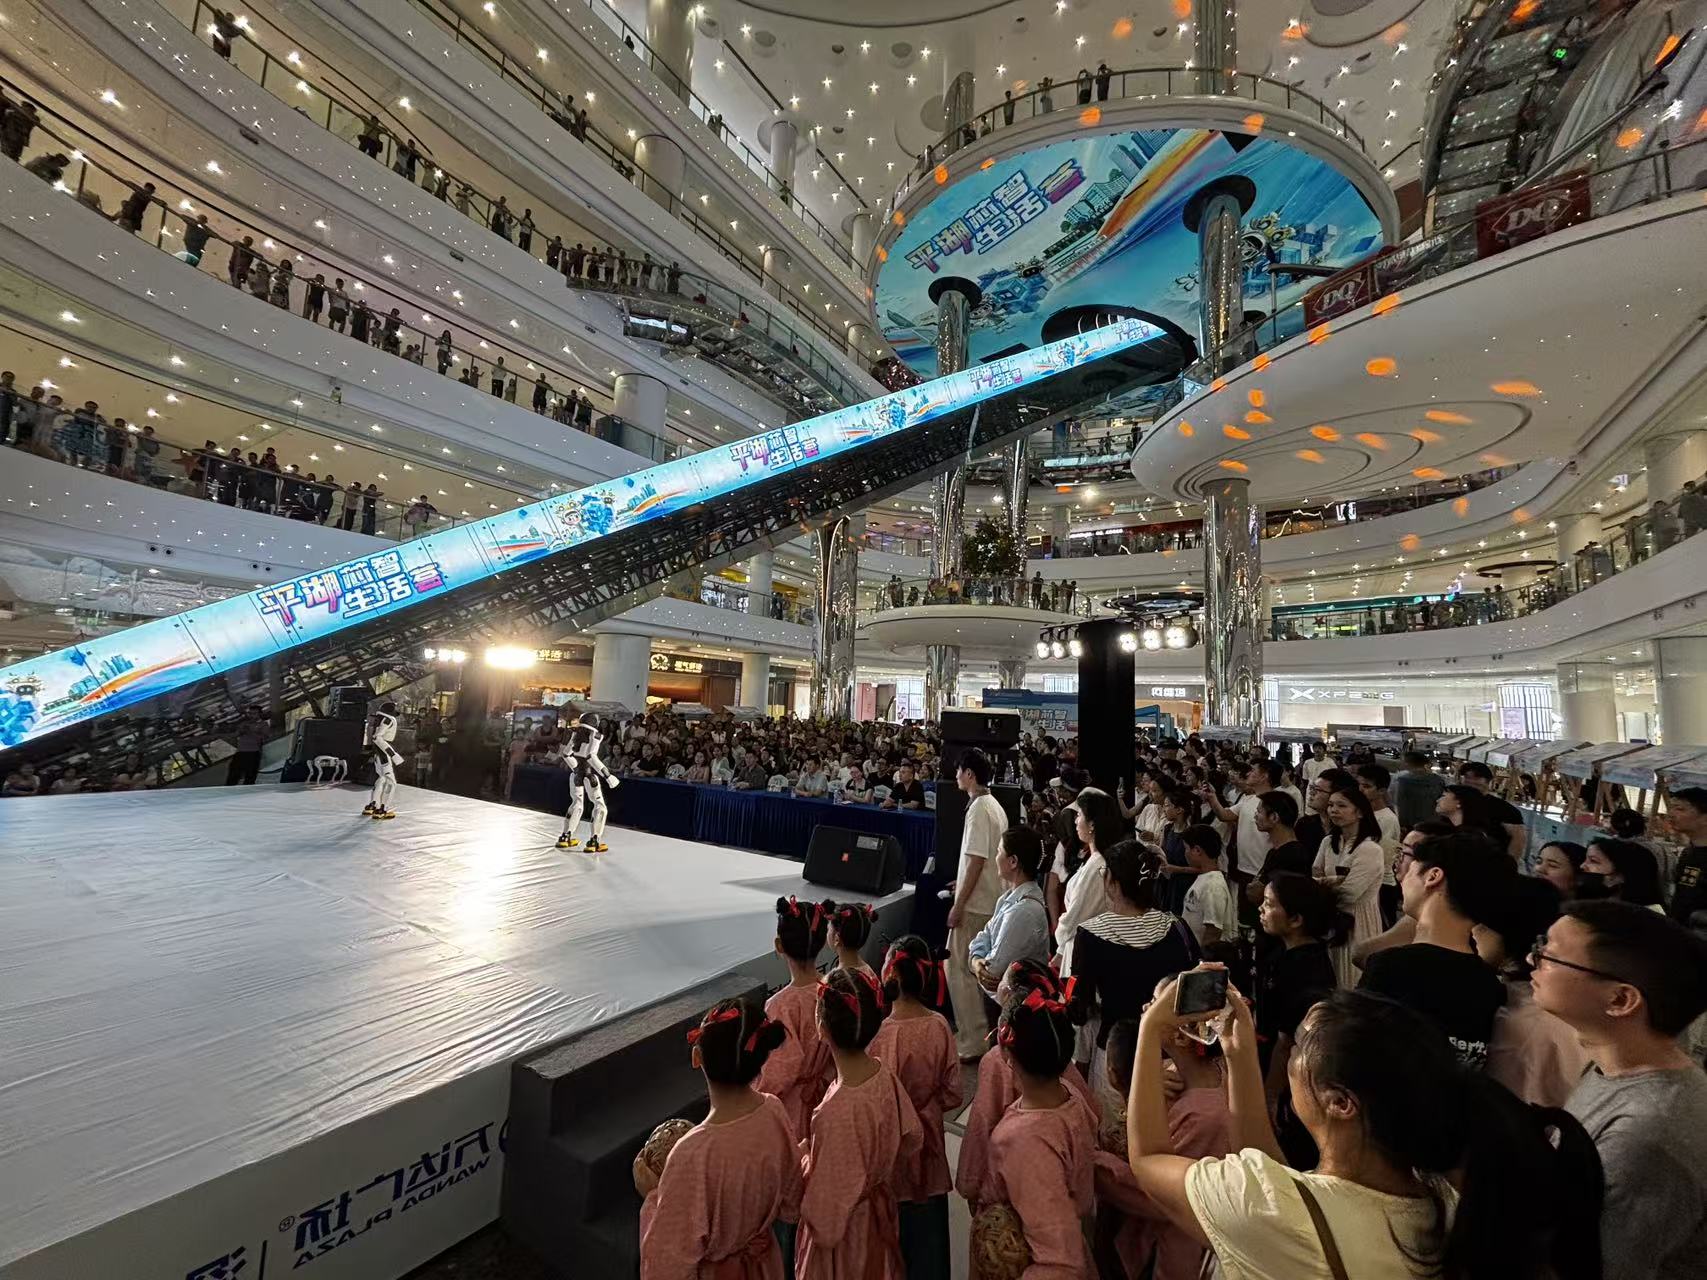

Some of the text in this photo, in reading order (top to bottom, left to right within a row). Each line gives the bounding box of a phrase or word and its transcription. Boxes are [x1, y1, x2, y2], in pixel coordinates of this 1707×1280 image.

[1506, 199, 1560, 232] DQ
[1323, 280, 1356, 310] DQ
[1317, 690, 1394, 700] XPEG
